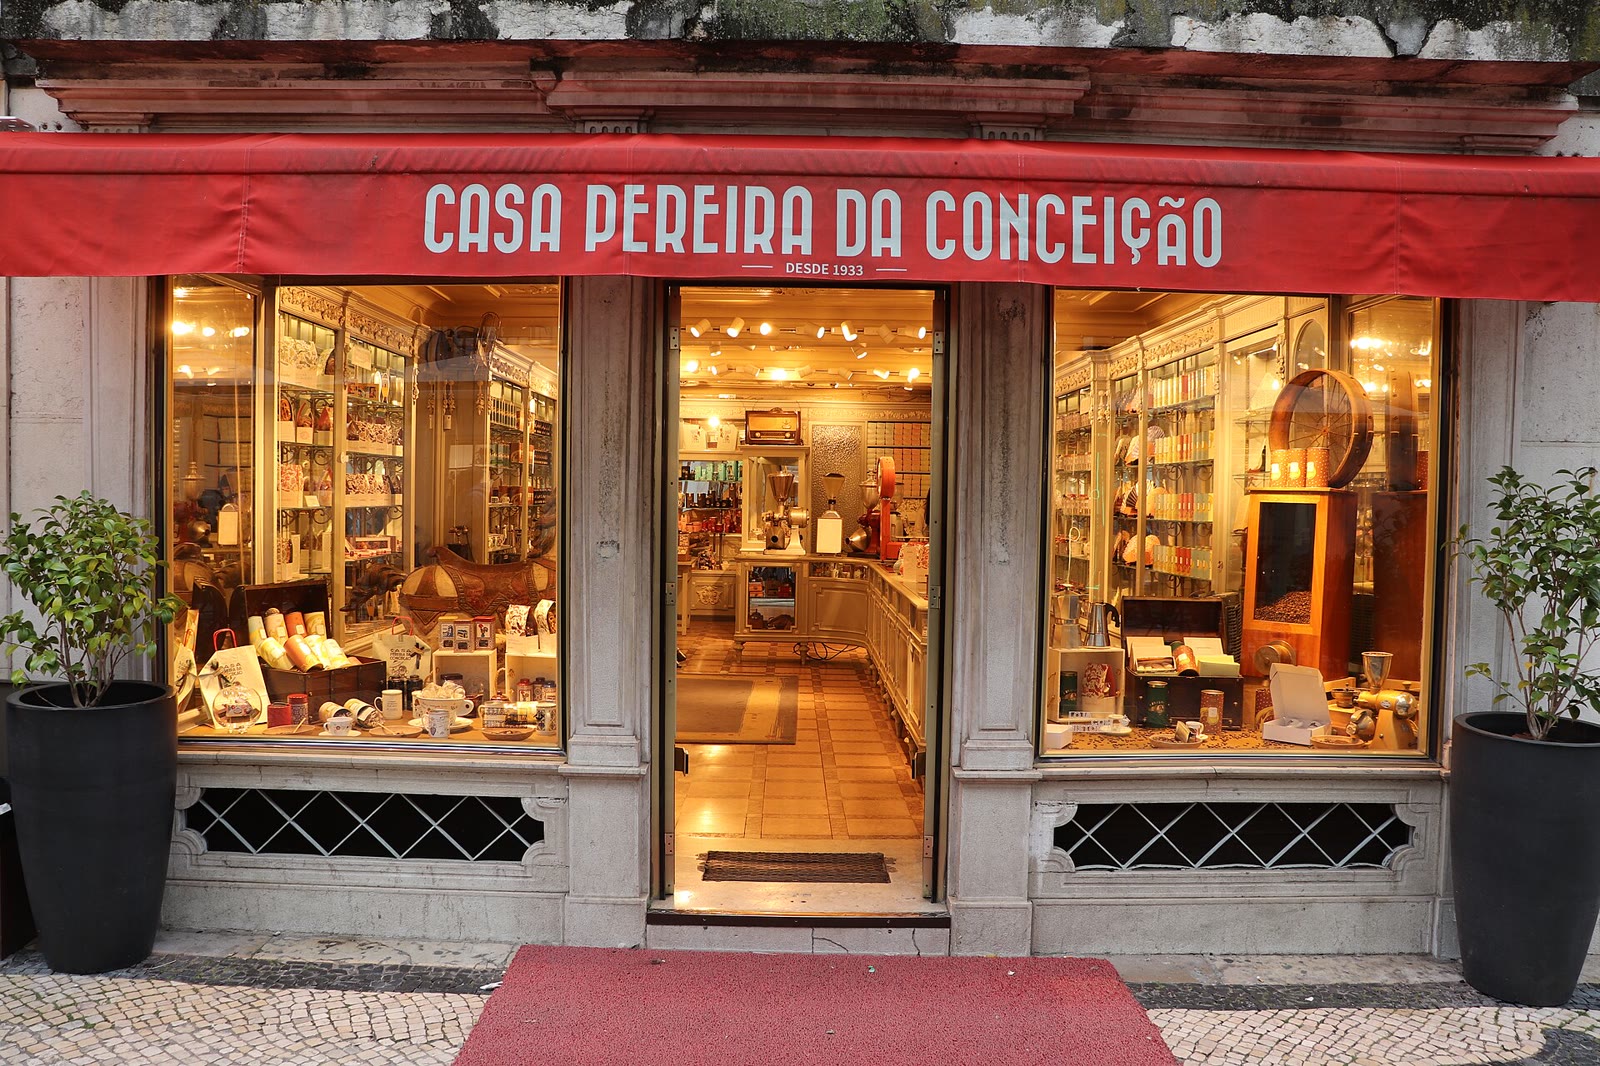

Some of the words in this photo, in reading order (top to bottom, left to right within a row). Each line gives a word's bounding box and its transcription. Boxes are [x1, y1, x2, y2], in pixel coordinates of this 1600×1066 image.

[424, 184, 562, 254] CASA
[584, 184, 813, 257] PEREIRA
[836, 189, 902, 258] DA
[926, 191, 1222, 269] CONCEIÇÃO
[785, 262, 829, 276] DESDE
[832, 264, 864, 278] 1933
